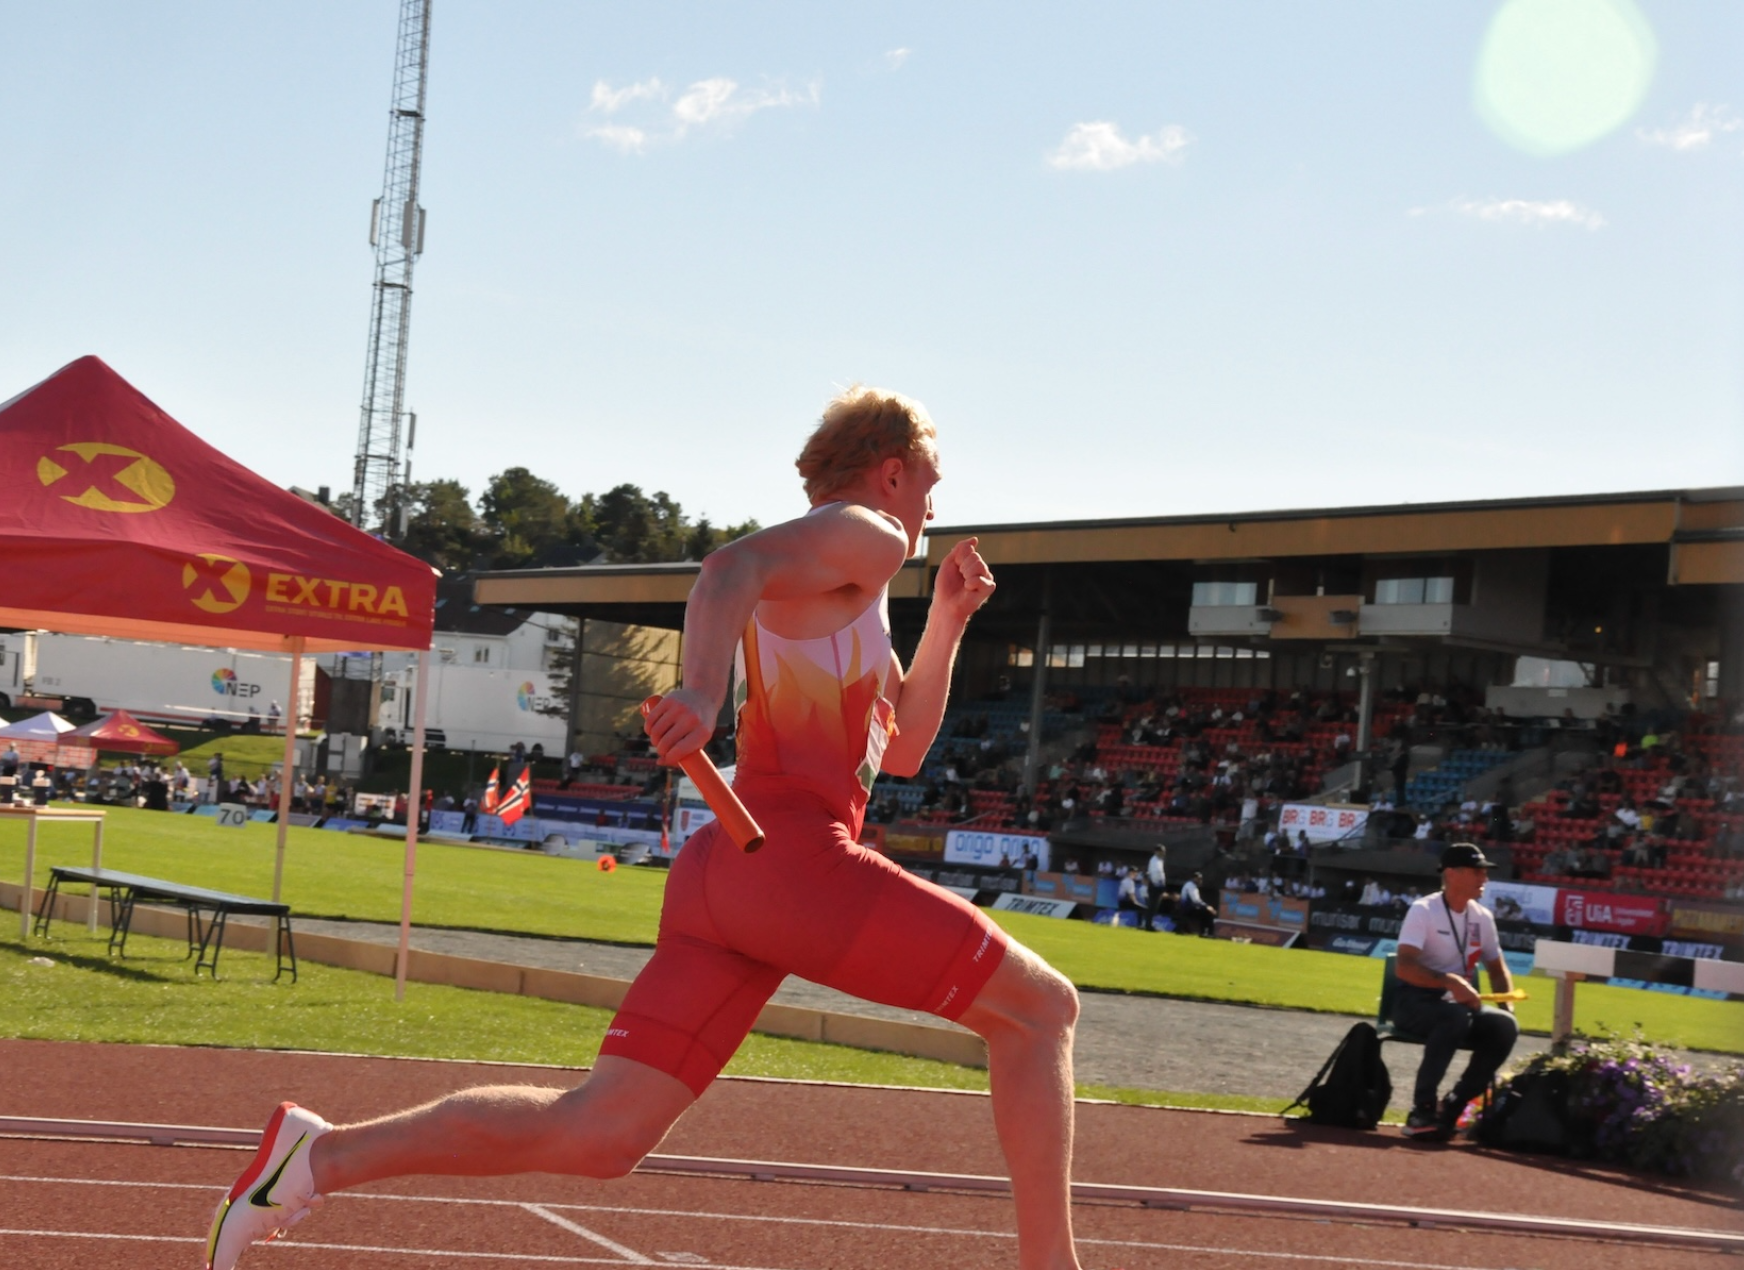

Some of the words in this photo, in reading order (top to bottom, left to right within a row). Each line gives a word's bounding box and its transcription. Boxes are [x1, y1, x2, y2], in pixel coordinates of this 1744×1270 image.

[265, 572, 409, 618] EXTRA
[226, 682, 261, 699] NEP
[219, 808, 246, 826] 70
[1282, 809, 1305, 825] BRG
[1309, 811, 1334, 827] BRG
[1005, 897, 1061, 916] TRIMTEX
[1572, 930, 1631, 950] TRIMTEX
[1662, 941, 1724, 961] TRIMTEX
